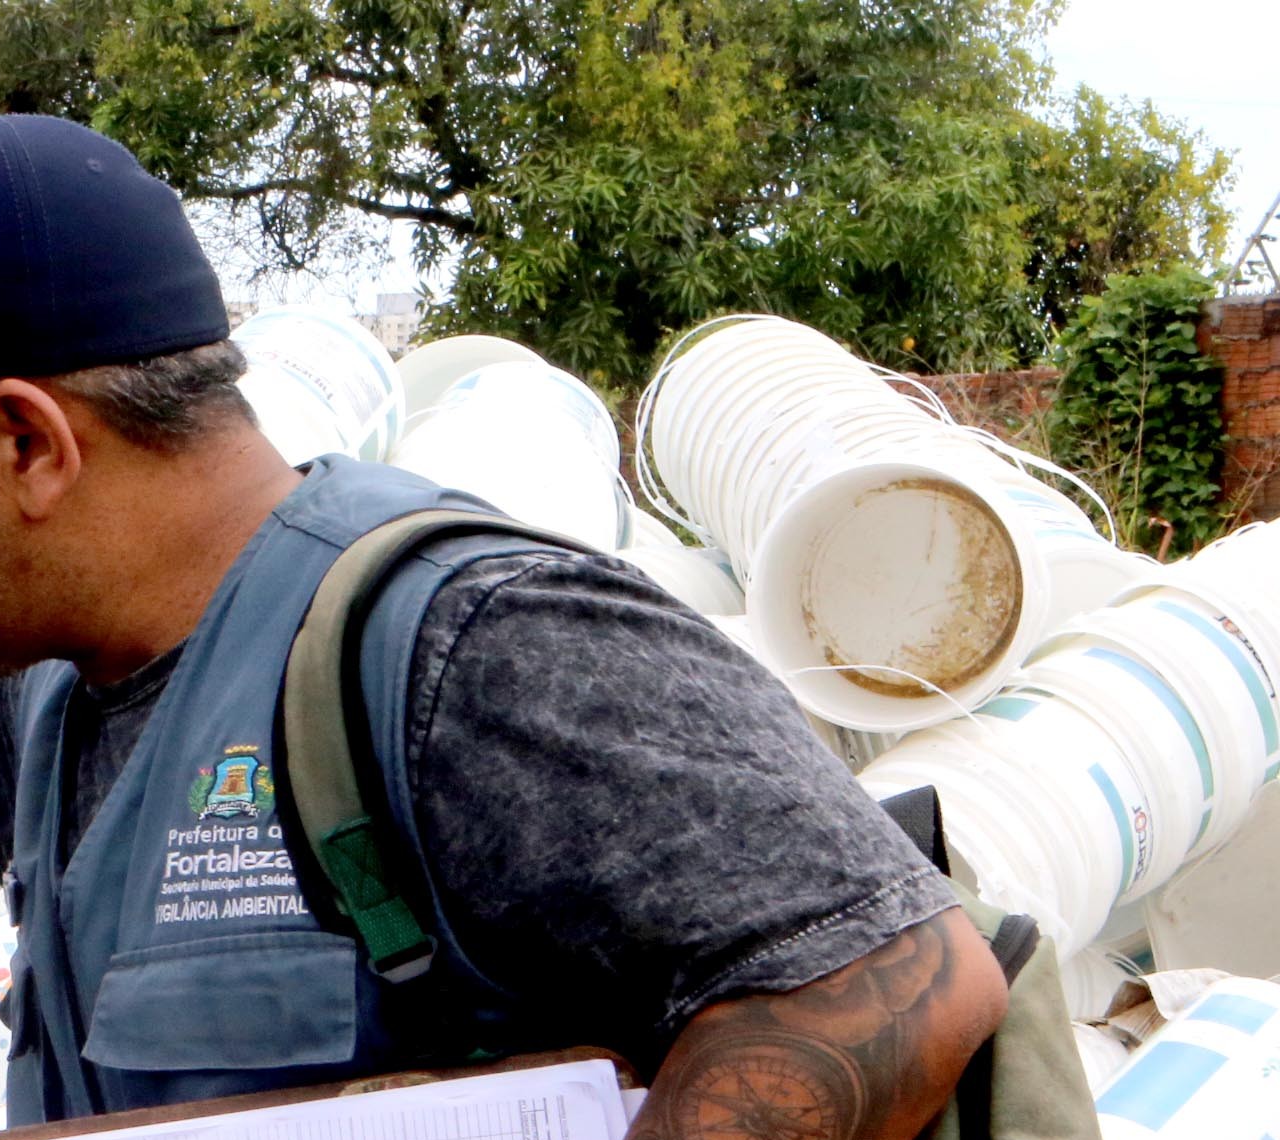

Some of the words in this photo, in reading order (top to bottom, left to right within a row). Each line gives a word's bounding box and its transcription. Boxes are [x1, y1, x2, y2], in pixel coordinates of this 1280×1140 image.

[168, 825, 258, 847] Prefeitura
[164, 845, 293, 878] Fortaleza
[245, 875, 258, 888] da
[260, 872, 297, 886] Saúde
[155, 895, 219, 925] VIGILÂNCIA
[221, 895, 309, 919] AMBIENTAL
